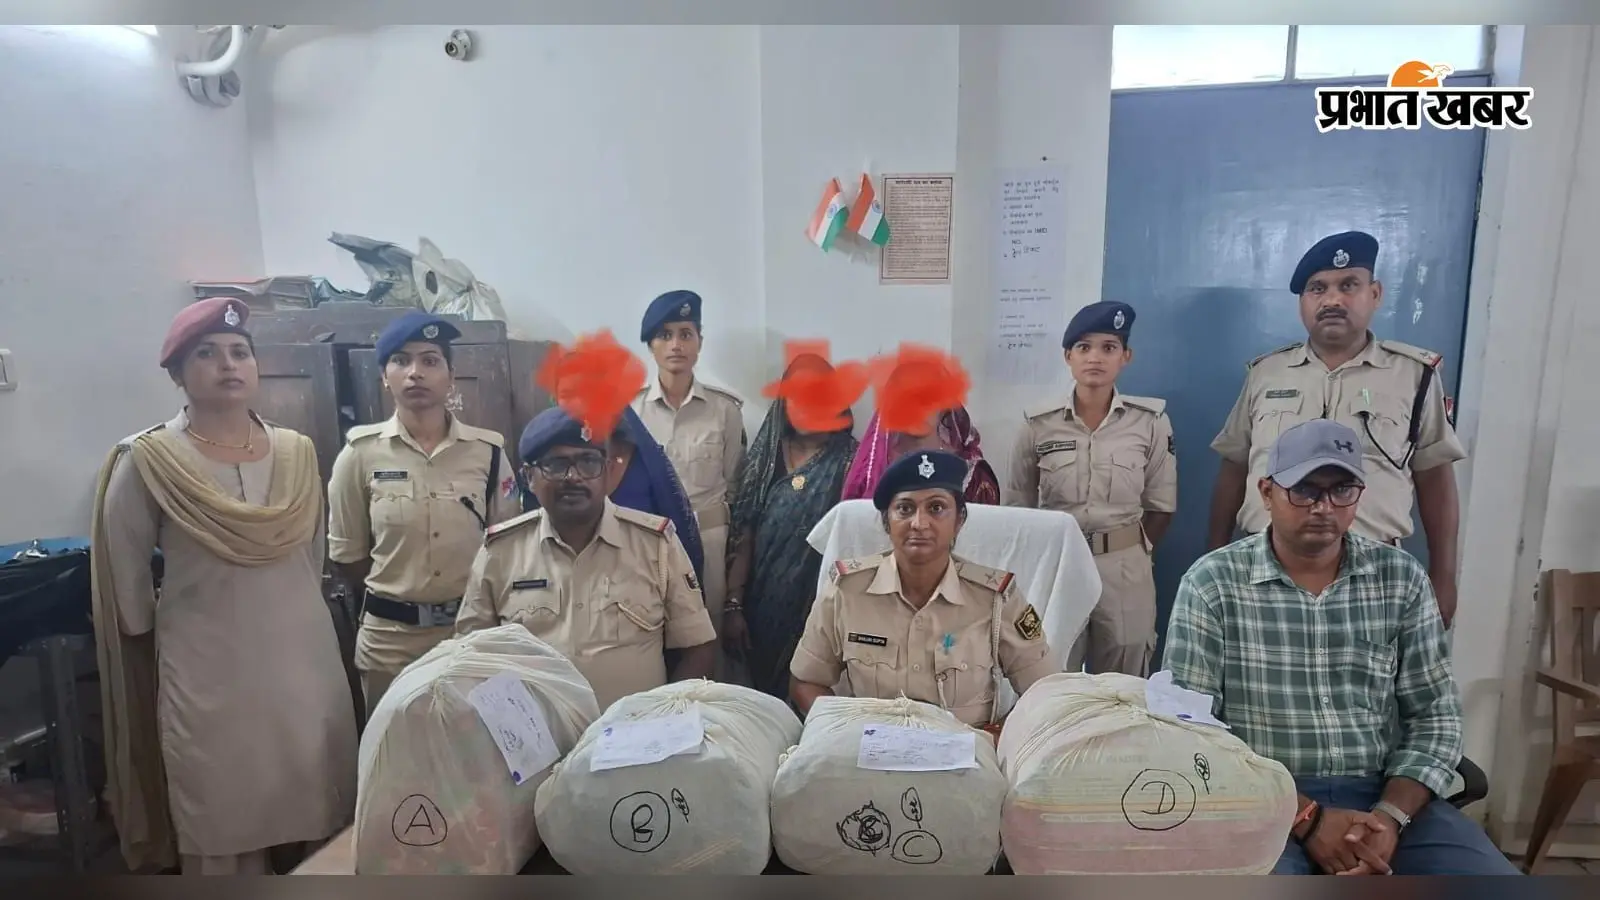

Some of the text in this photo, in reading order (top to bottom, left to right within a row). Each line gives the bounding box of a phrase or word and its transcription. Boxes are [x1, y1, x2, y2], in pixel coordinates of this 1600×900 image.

[1140, 780, 1176, 815] D
[404, 803, 436, 836] A
[631, 803, 654, 844] B
[903, 834, 925, 858] C
